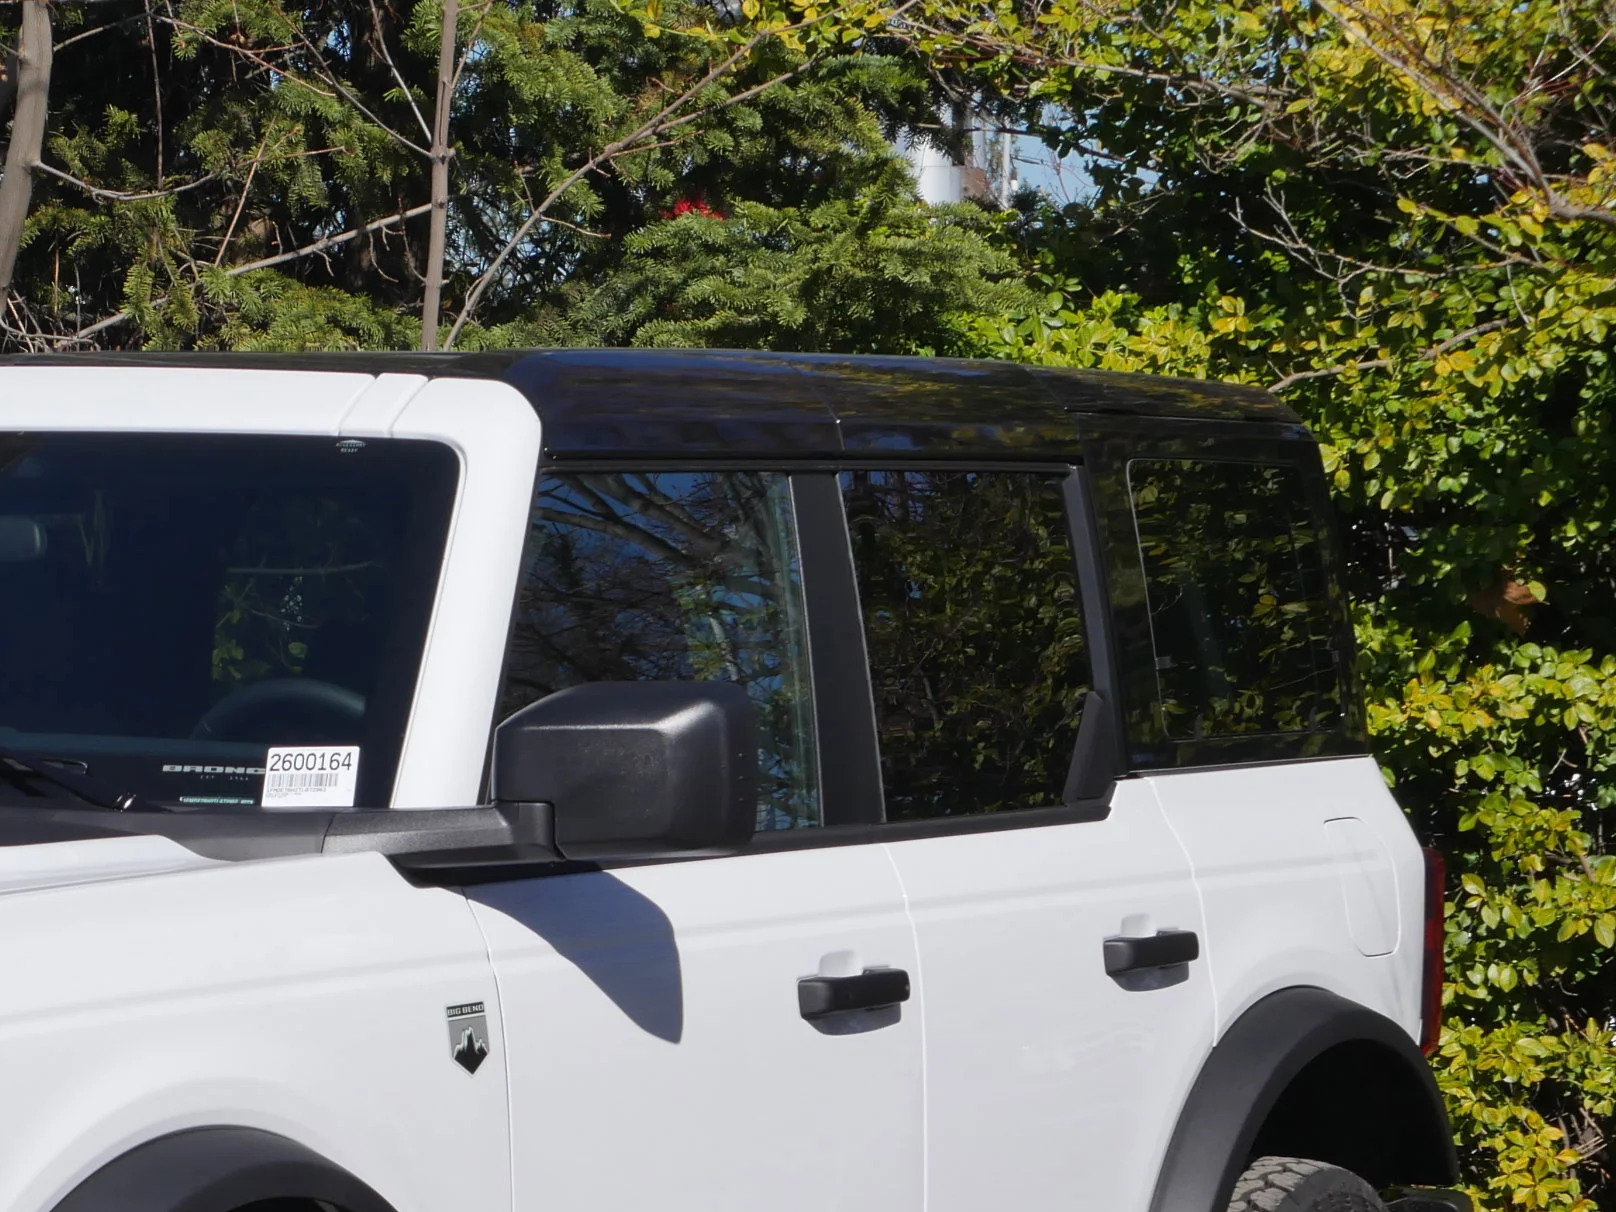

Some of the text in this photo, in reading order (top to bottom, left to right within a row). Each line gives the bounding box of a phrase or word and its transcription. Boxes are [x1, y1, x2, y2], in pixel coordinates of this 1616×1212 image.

[269, 752, 352, 772] 2600164
[162, 765, 267, 774] BRONC
[447, 1004, 484, 1016] BIG BEND
